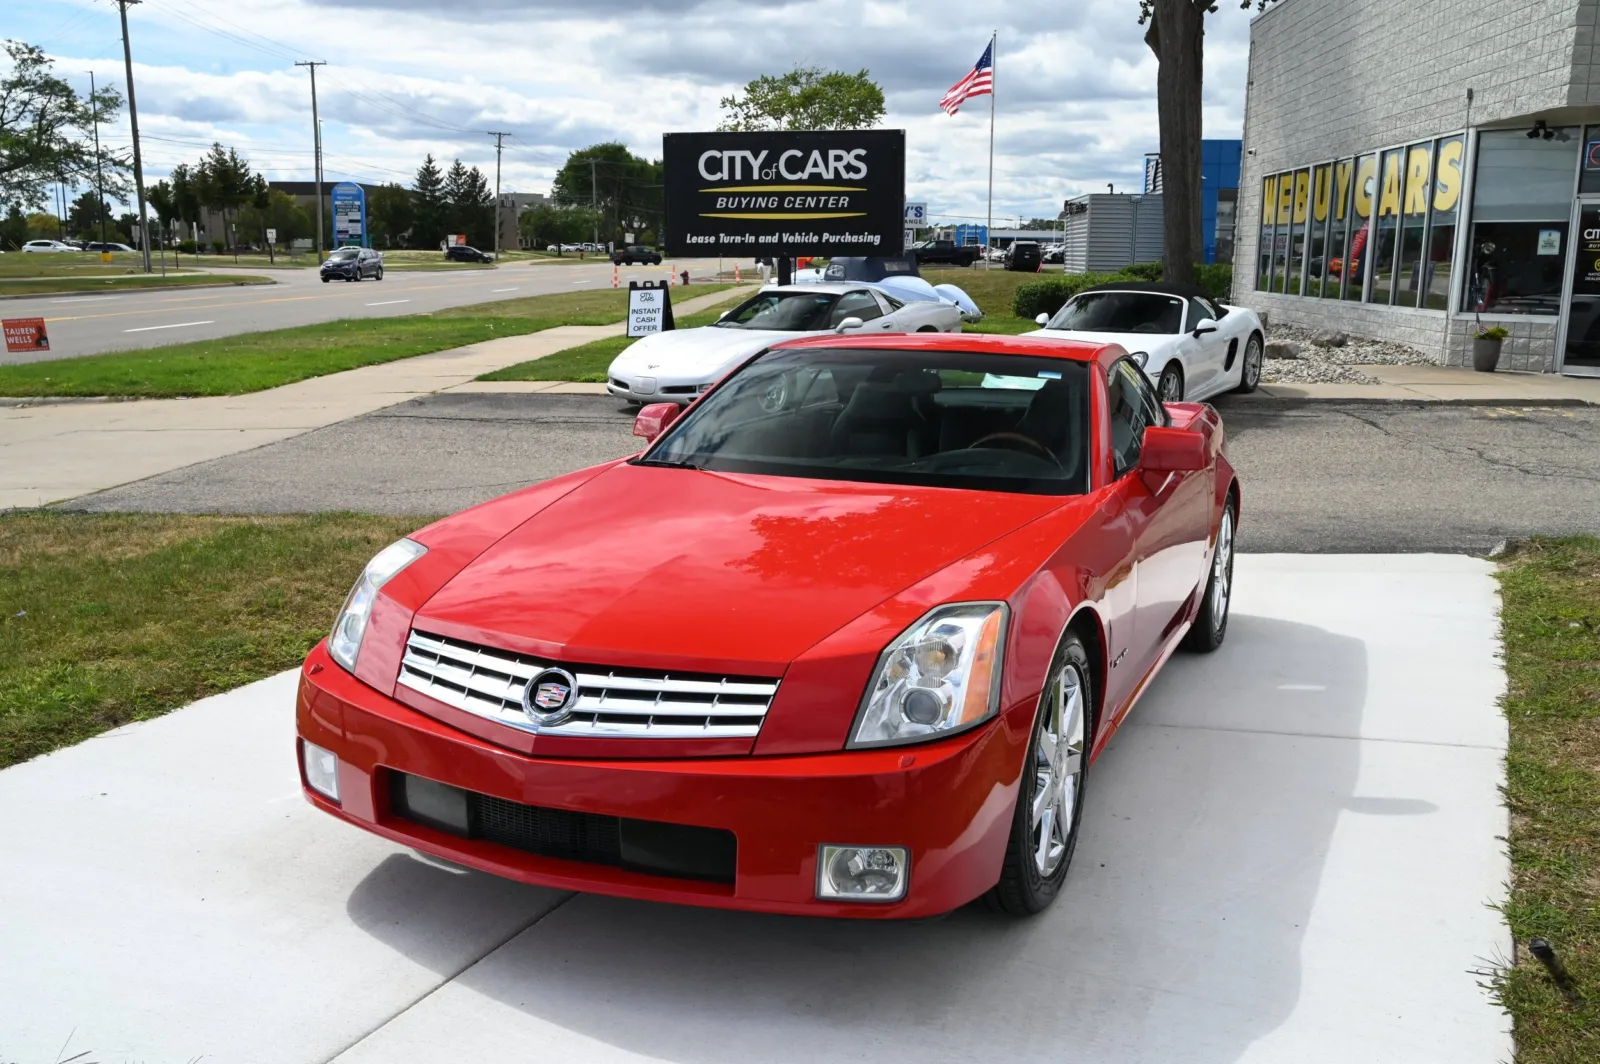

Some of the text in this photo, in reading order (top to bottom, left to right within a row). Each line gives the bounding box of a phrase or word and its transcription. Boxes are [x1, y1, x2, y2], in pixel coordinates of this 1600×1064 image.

[698, 148, 868, 181] CITY of CARS
[716, 195, 850, 209] BUYING CENTER
[686, 232, 881, 246] Lease Turn-In and Vehicle Purchasing
[7, 336, 32, 344] WELLS
